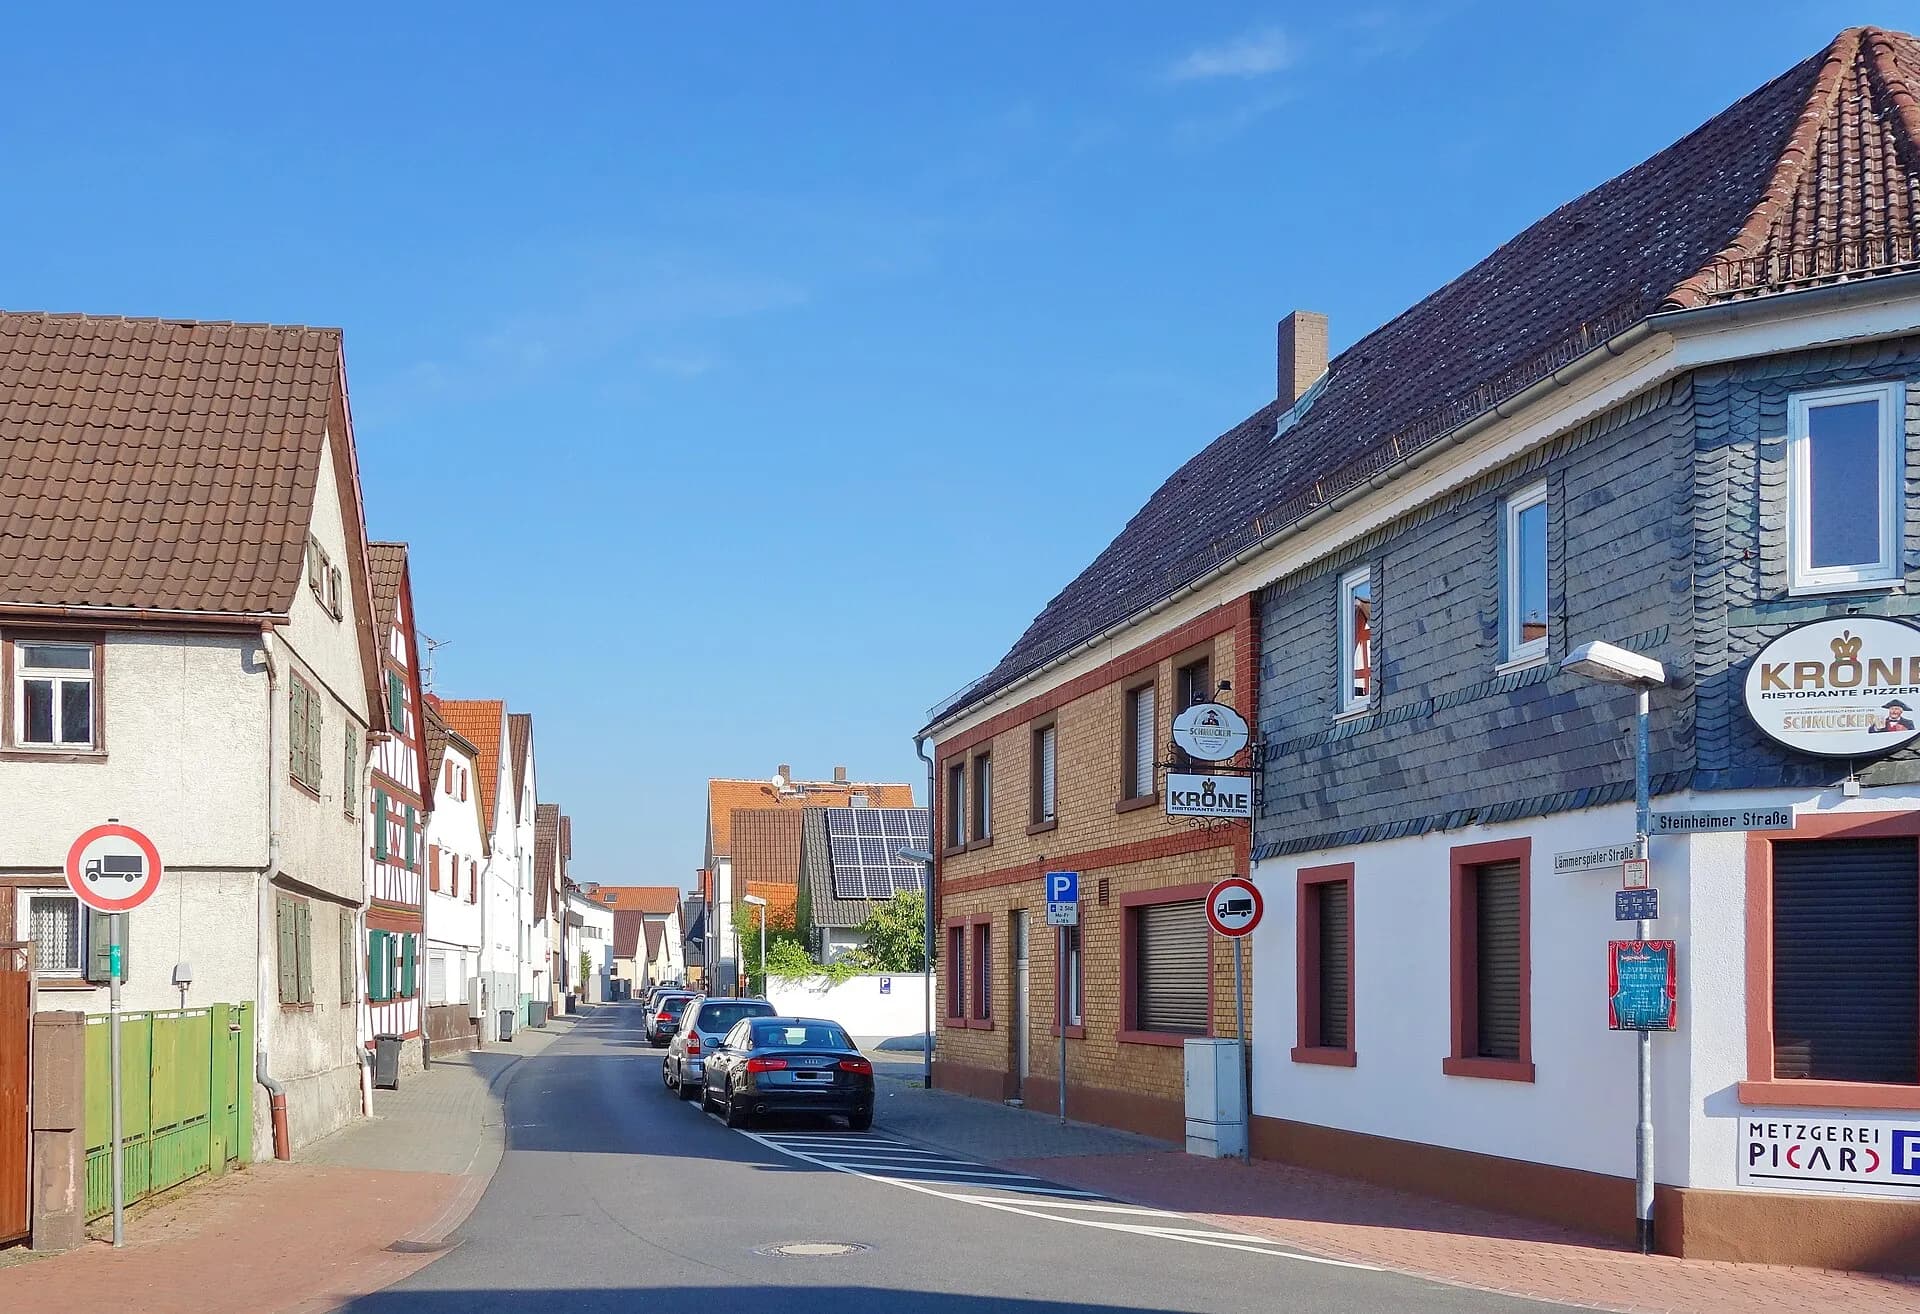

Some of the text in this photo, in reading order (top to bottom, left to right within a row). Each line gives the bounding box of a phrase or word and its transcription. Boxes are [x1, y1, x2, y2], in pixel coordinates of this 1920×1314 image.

[1761, 689, 1857, 700] RISTORANTE
[1783, 712, 1876, 730] SCHMUCKER
[1189, 727, 1232, 737] SCHMUCKER
[1171, 791, 1248, 809] KRONE
[1660, 811, 1789, 829] Steinheimer Straße
[1554, 847, 1634, 869] Lämmerspieler Straße
[1054, 877, 1070, 900] P
[882, 979, 889, 988] P
[1749, 1122, 1879, 1144] METZGEREI
[1749, 1142, 1880, 1174] PICARD
